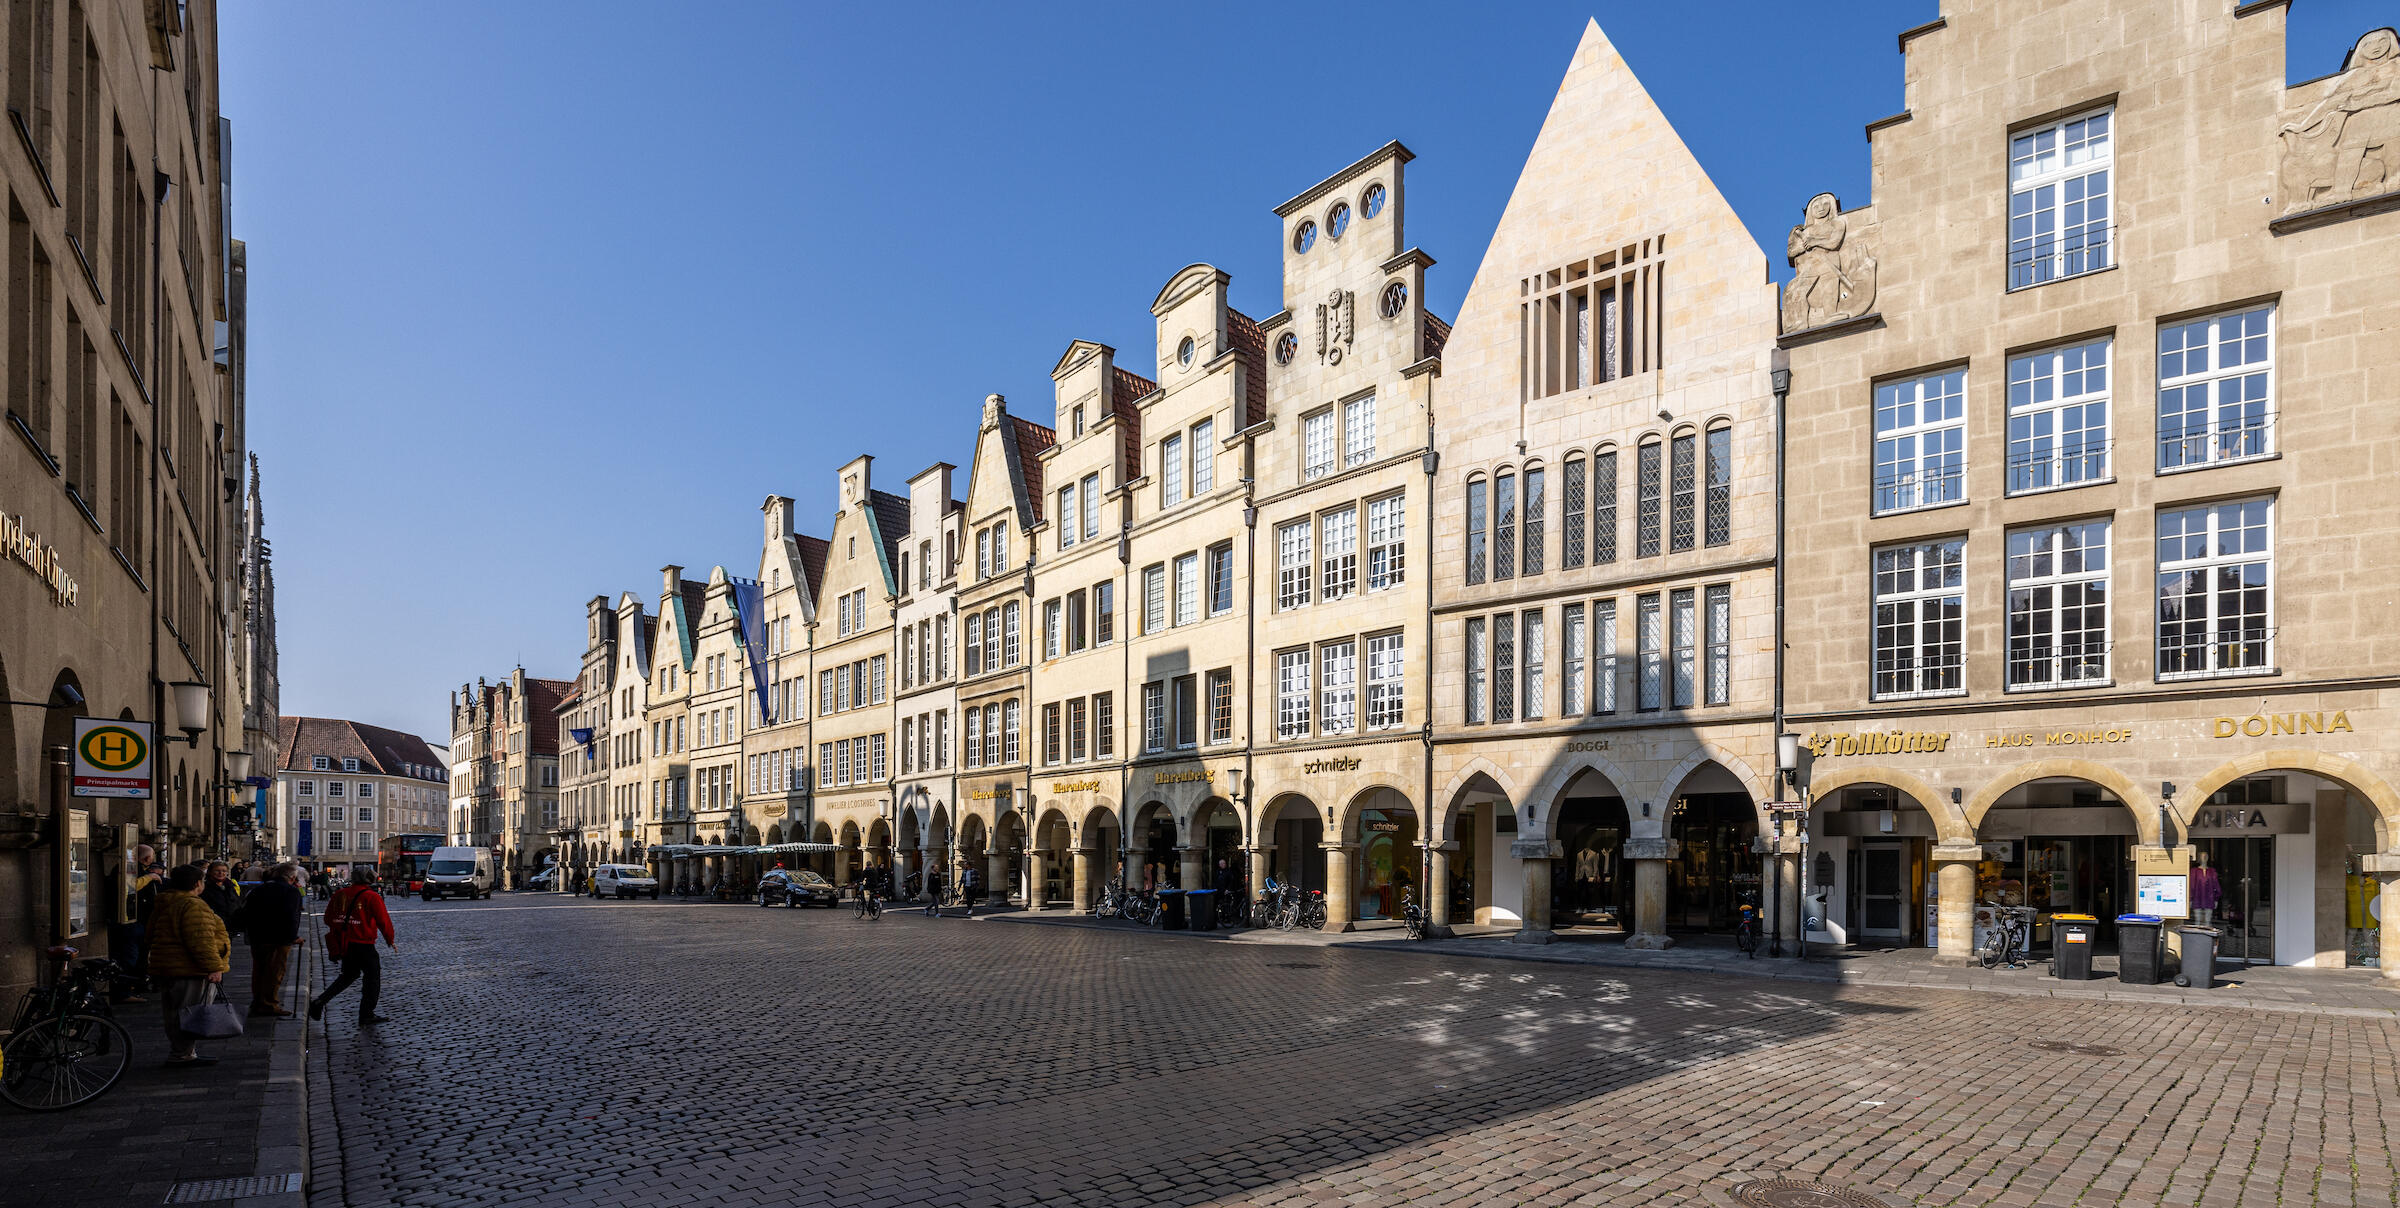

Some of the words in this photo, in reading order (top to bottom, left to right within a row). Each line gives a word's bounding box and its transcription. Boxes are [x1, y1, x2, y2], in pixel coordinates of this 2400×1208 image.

[2214, 710, 2353, 738] DONNA
[1568, 741, 1609, 752] BOGGI
[1833, 730, 1950, 756] Tollkötter
[1986, 734, 2033, 748] HAUS
[2046, 729, 2132, 745] MONHOF
[101, 736, 126, 761] H
[1304, 756, 1361, 774] schnitzler
[1155, 769, 1215, 785] Harenberg
[973, 789, 1011, 800] Harenberg
[1053, 780, 1100, 794] Harenberg
[1373, 822, 1400, 832] schnitzler
